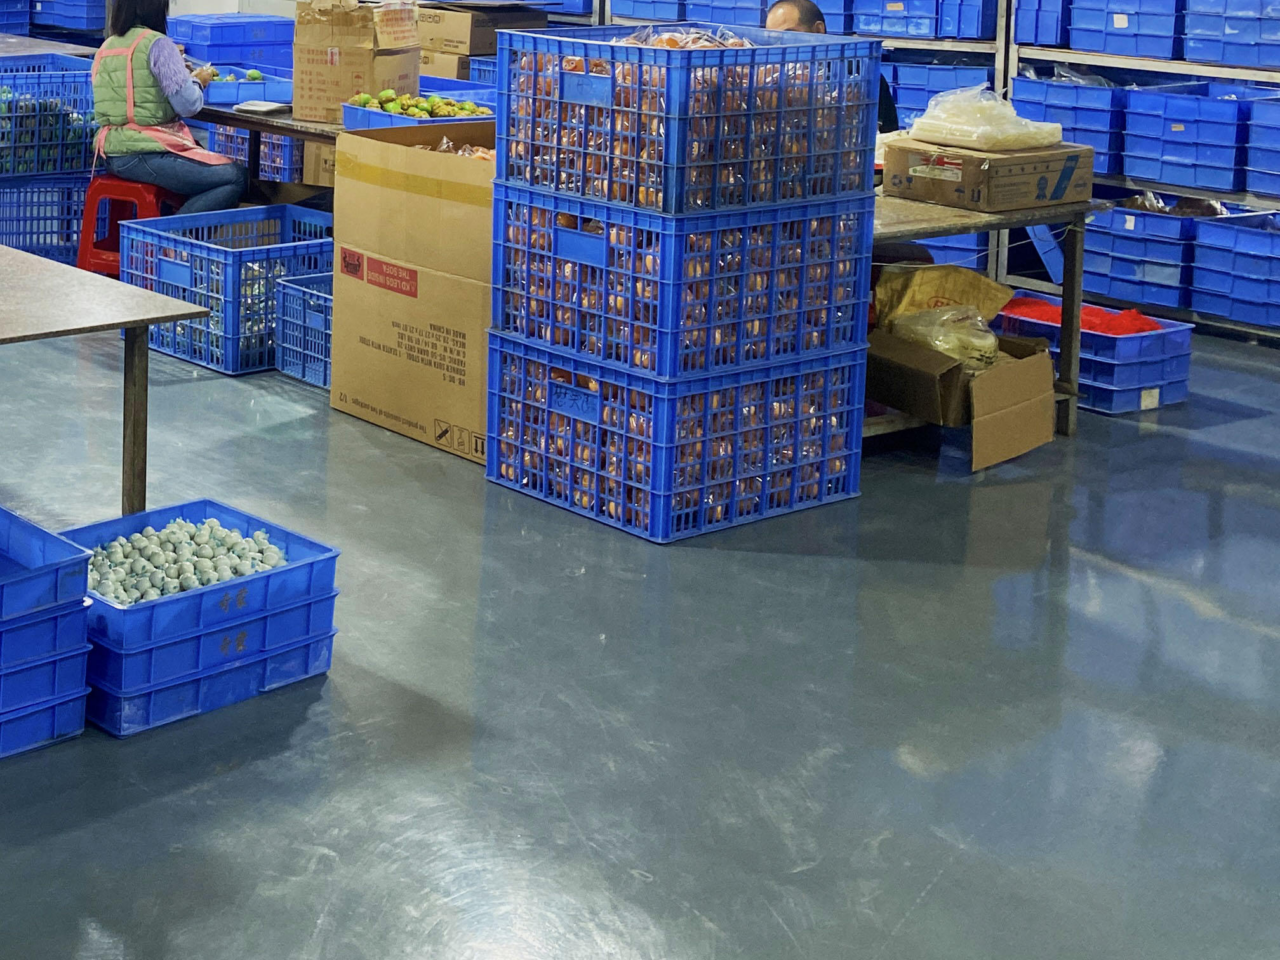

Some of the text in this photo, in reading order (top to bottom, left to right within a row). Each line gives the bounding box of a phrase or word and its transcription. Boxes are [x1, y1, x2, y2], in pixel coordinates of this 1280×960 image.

[382, 264, 410, 279] THE SOFA
[367, 271, 410, 291] KD LEGS INSIDE
[430, 323, 466, 340] MADE IN CHINA
[446, 365, 466, 376] CORNER
